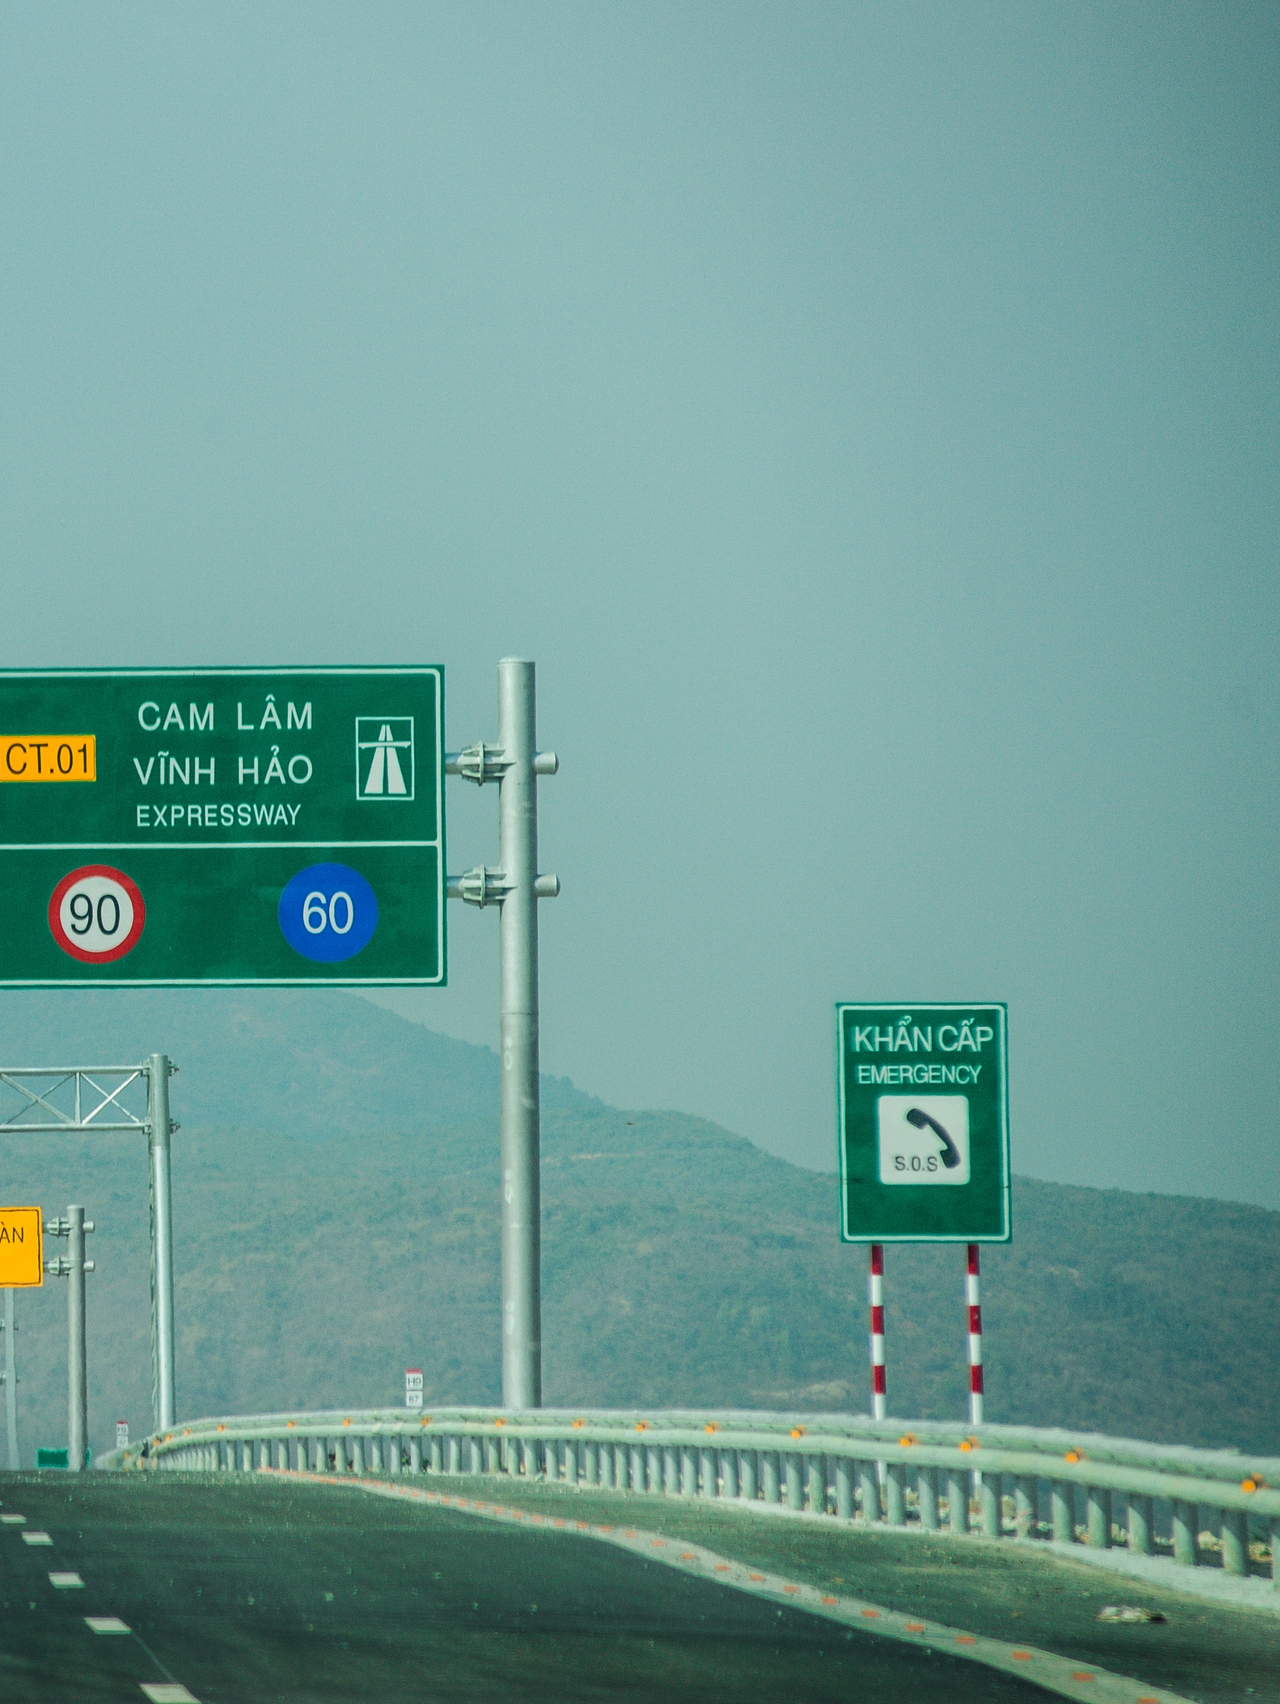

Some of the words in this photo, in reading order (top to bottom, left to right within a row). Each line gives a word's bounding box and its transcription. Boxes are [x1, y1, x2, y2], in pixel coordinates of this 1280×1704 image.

[138, 702, 216, 731] CAM
[237, 695, 313, 730] LÂM
[5, 743, 91, 776] CT.01
[133, 751, 216, 786] VĨNH
[238, 745, 313, 785] HẢO
[136, 804, 302, 828] EXPRESSWAY
[69, 893, 121, 935] 90
[302, 891, 354, 934] 60
[854, 1015, 932, 1052] KHẨN
[938, 1017, 994, 1052] CẤP
[858, 1064, 982, 1084] EMERGENCY
[894, 1156, 938, 1172] S.O.S
